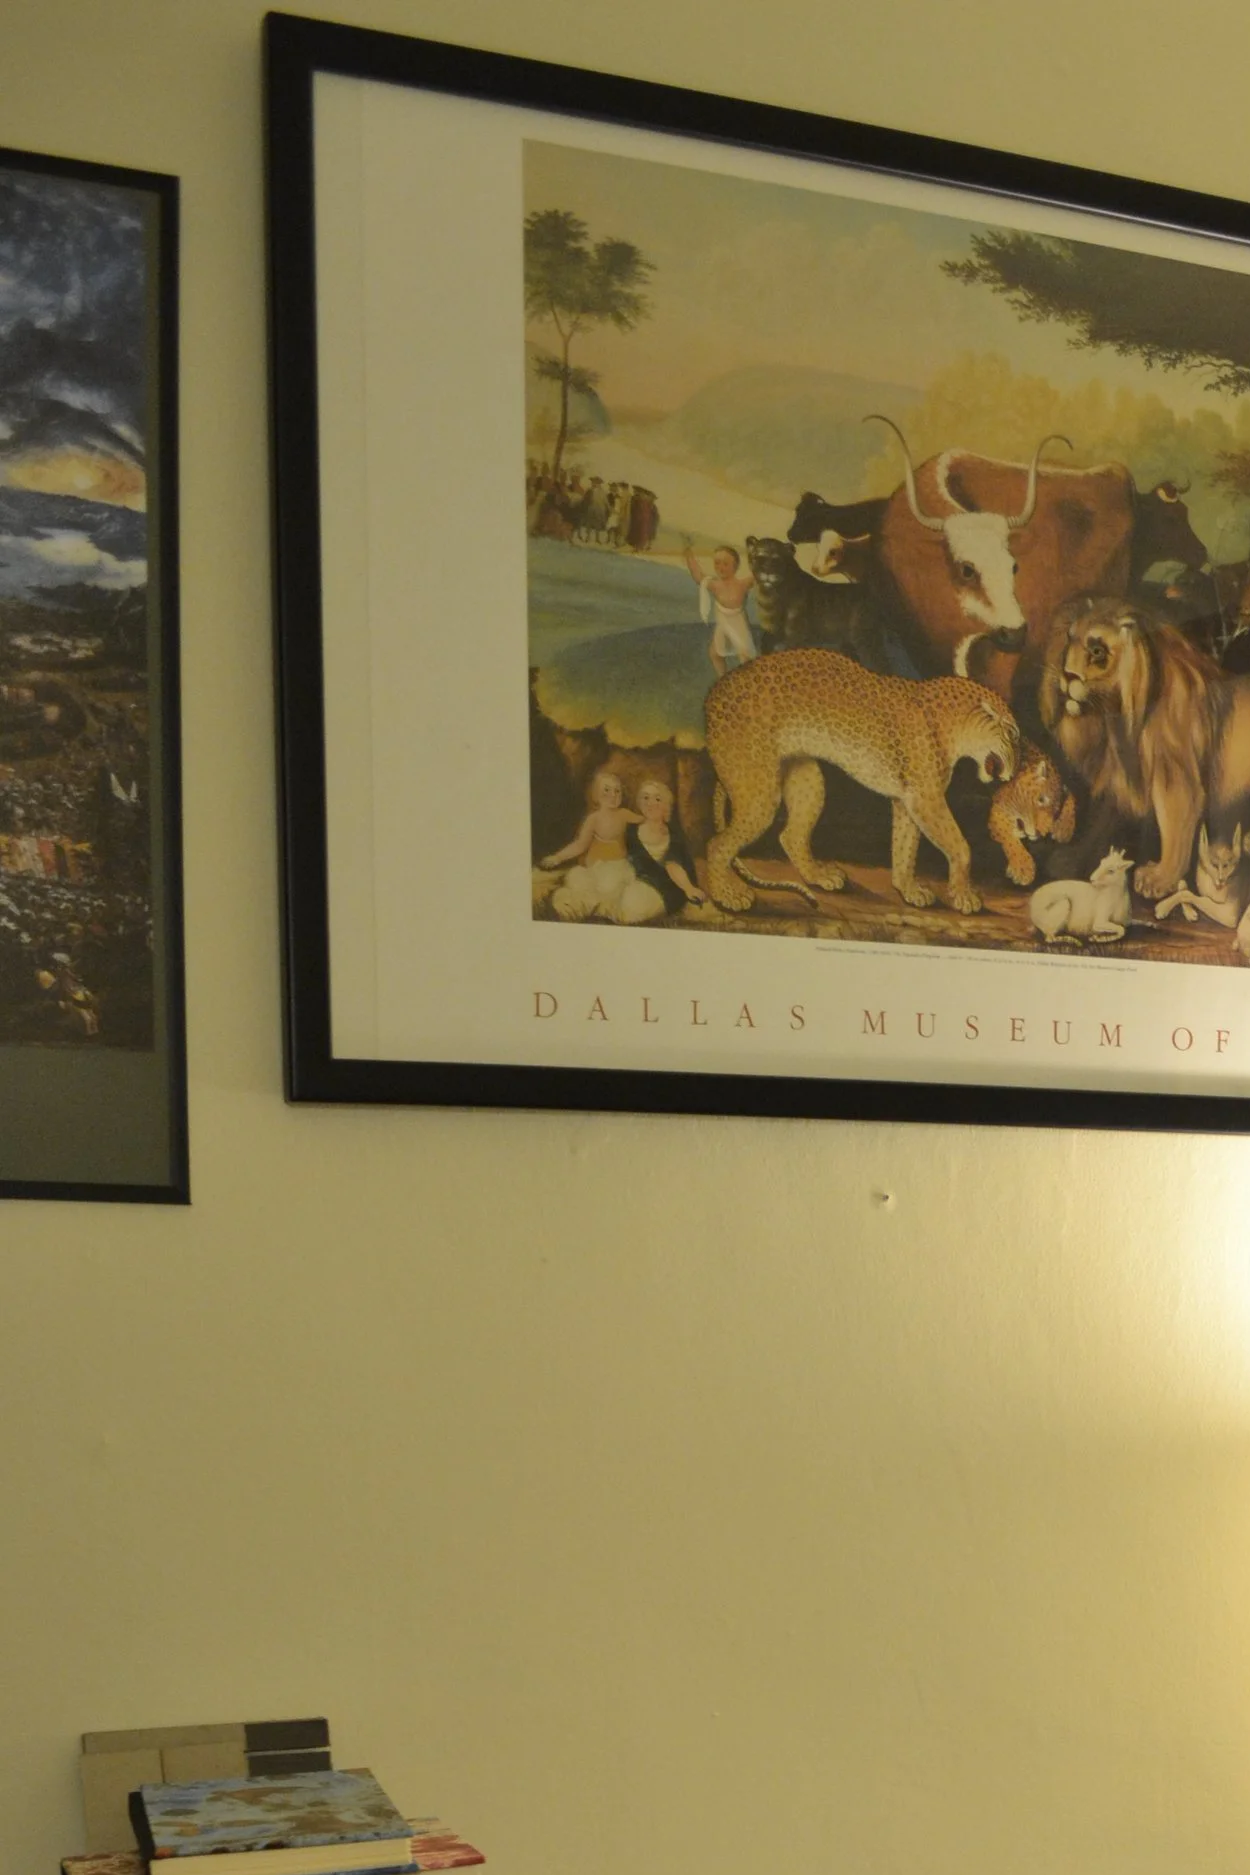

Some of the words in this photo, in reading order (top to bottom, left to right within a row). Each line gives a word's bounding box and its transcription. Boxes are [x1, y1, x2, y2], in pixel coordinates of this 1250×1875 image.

[532, 991, 806, 1031] DALLAS
[862, 1009, 1124, 1049] MUSEUM
[1171, 1026, 1231, 1053] OF
